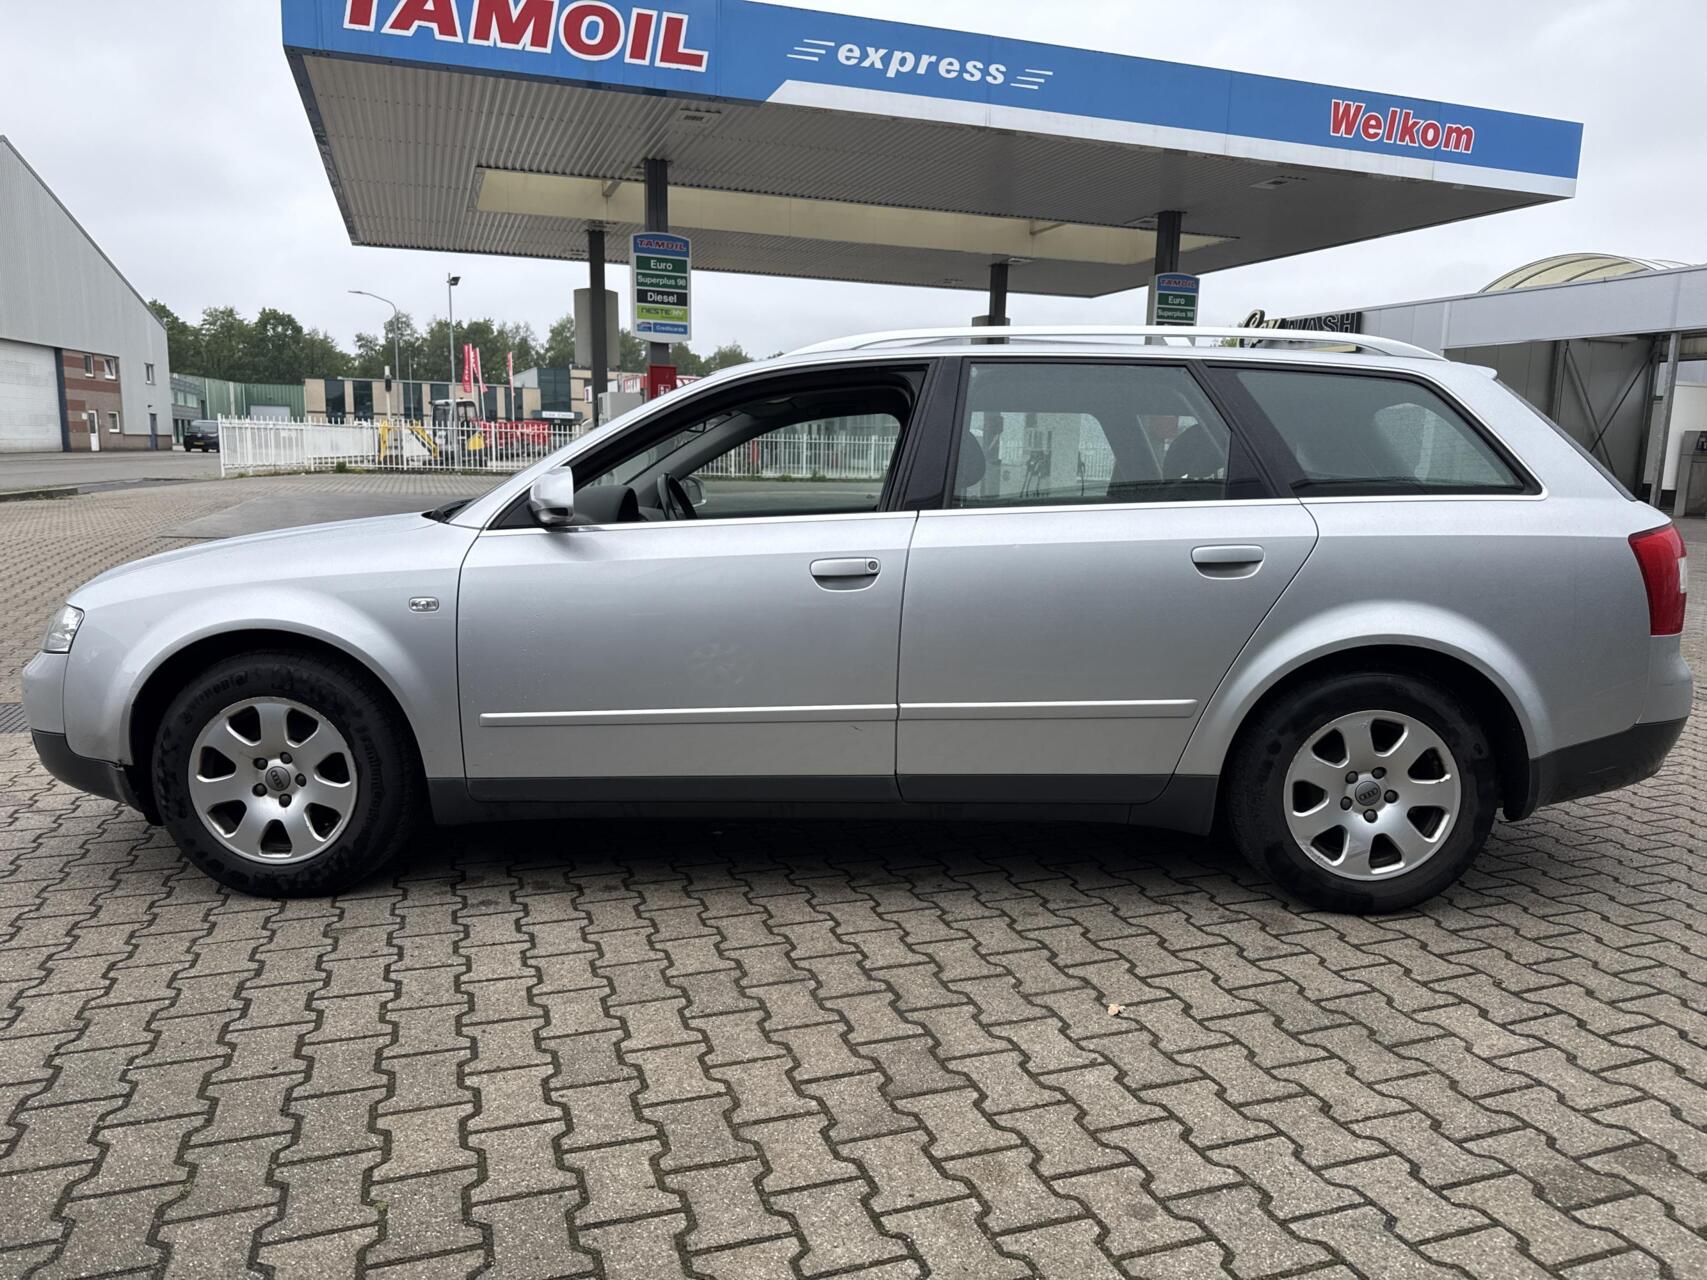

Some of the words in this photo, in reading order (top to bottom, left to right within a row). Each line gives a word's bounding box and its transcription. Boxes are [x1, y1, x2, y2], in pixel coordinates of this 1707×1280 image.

[837, 43, 1007, 85] express
[1330, 99, 1475, 154] Welkom
[637, 239, 687, 251] TAMOIL
[650, 259, 673, 270] Euro
[637, 275, 676, 286] Superplus
[1161, 279, 1197, 288] TAMOIL
[647, 292, 677, 303] Diesel
[1168, 296, 1185, 304] Euro
